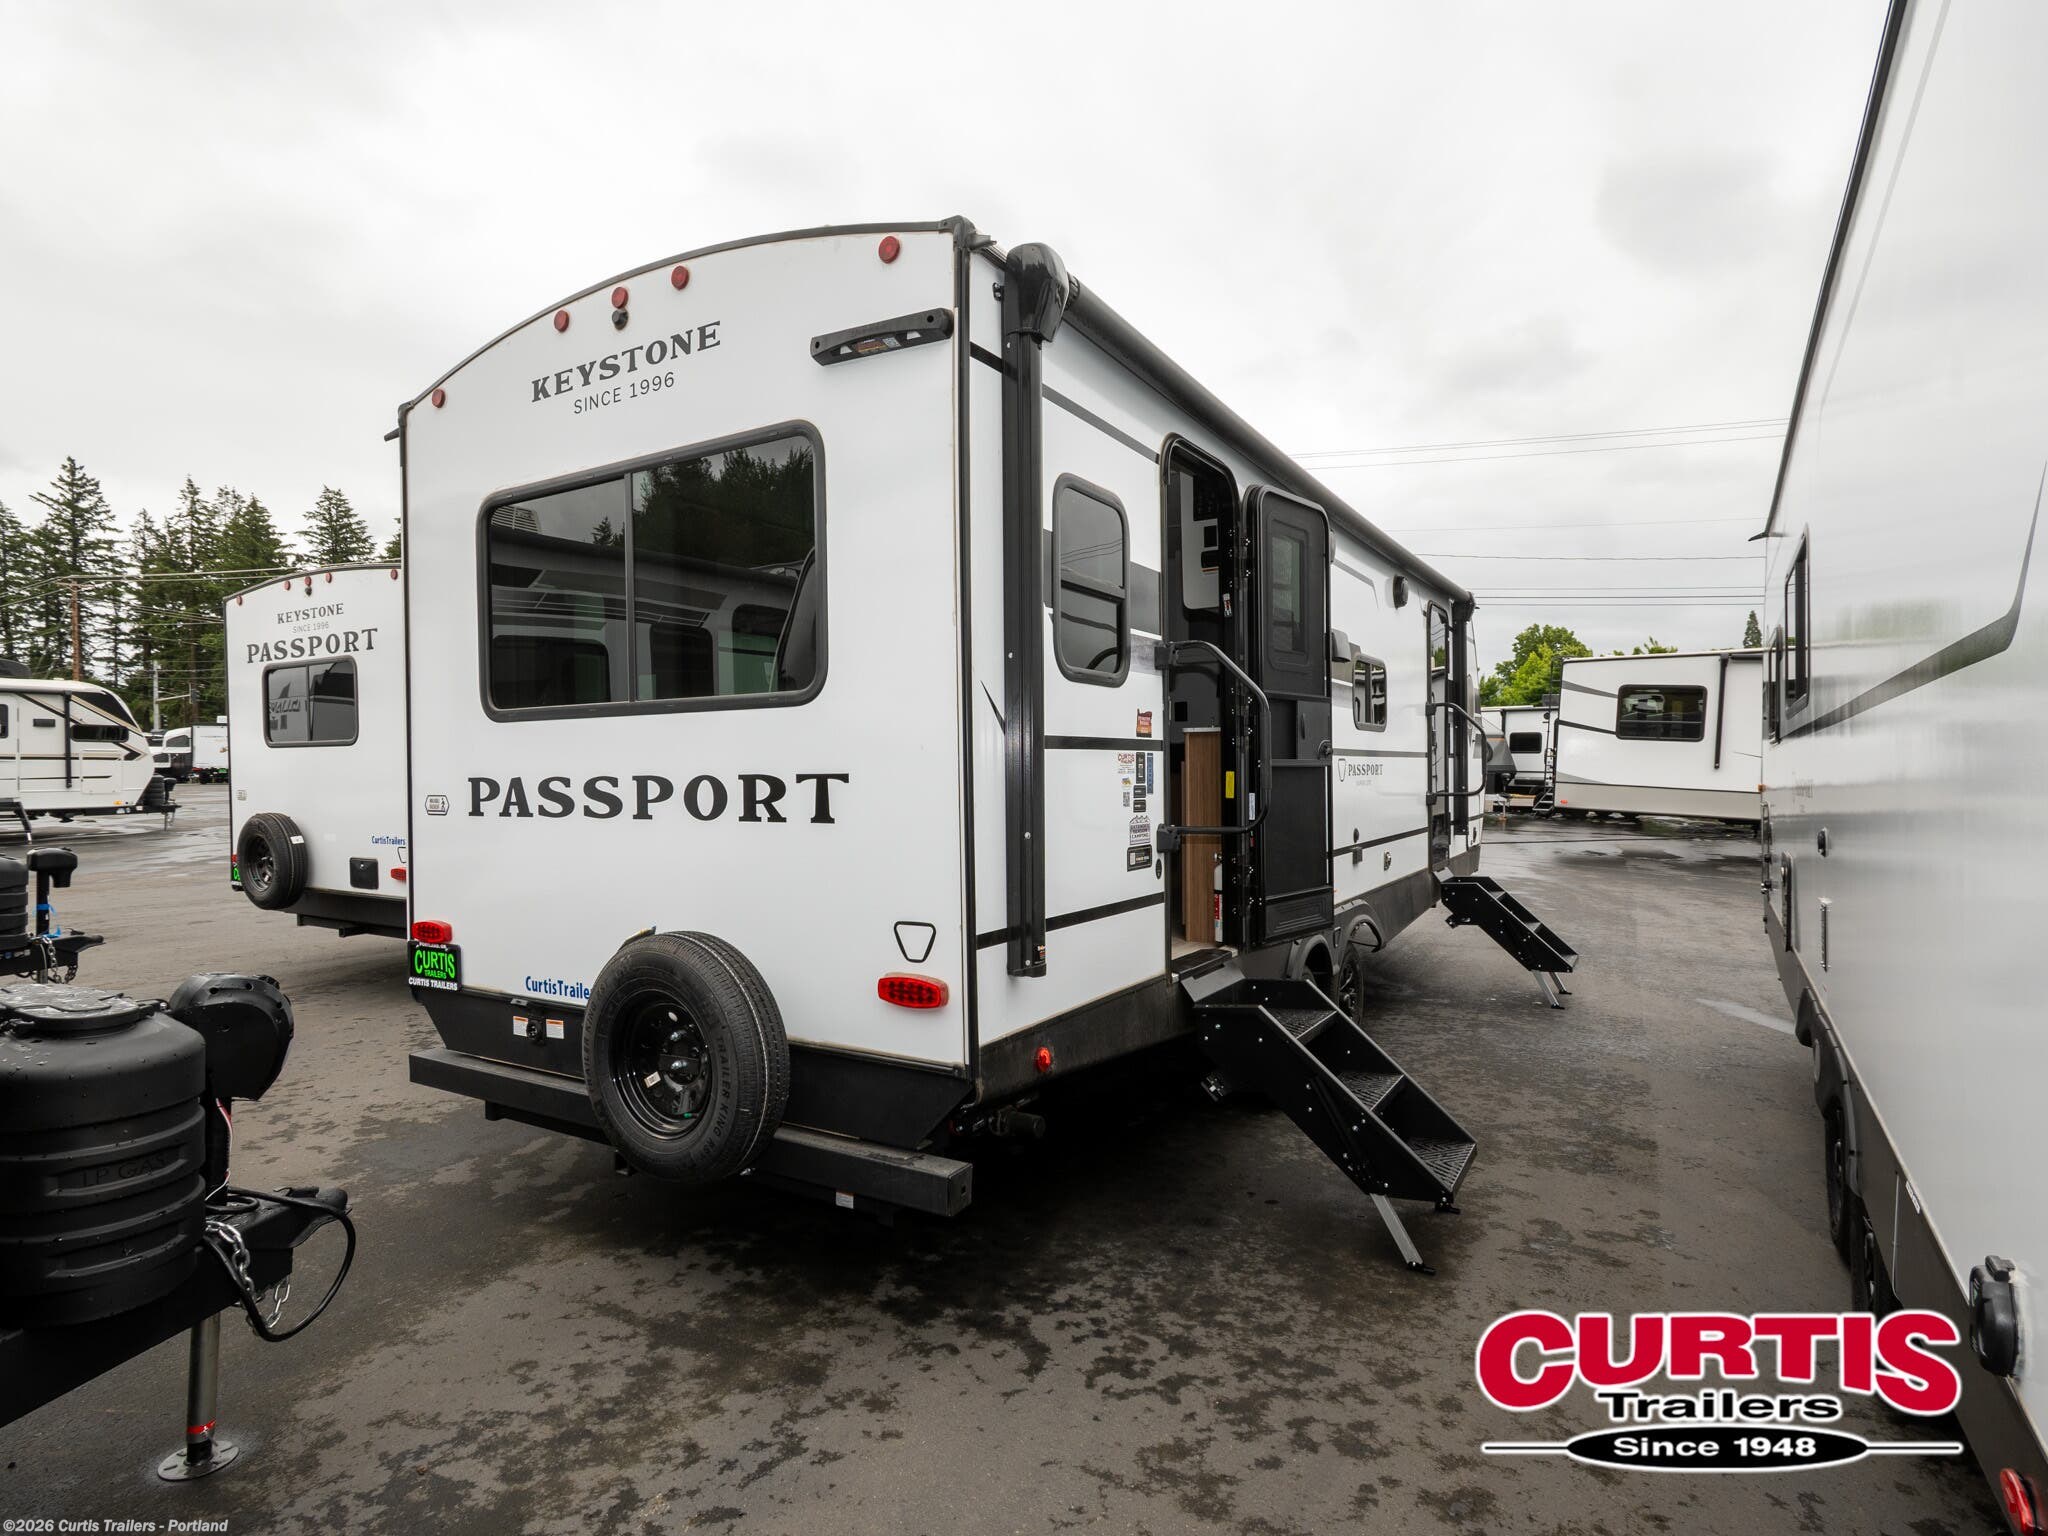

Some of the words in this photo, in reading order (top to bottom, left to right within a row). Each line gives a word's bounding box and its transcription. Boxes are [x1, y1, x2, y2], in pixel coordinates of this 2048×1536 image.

[531, 320, 721, 403] KEYSTONE
[574, 386, 622, 414] SINCE
[629, 371, 675, 399] 1996
[276, 602, 344, 624] KEYSTONE
[292, 623, 311, 634] SINCE
[313, 621, 330, 631] 1996
[246, 627, 378, 664] PASSPORT
[1348, 763, 1383, 777] PASSPORT
[468, 773, 850, 824] PASSPORT
[414, 949, 456, 979] CURTIS
[424, 969, 447, 980] TRAILERS
[408, 976, 430, 987] CURTIS
[430, 979, 458, 991] TRAILERS
[525, 975, 591, 1000] CurtisTraile
[715, 1035, 730, 1098] TRAILER
[712, 1103, 729, 1137] KING
